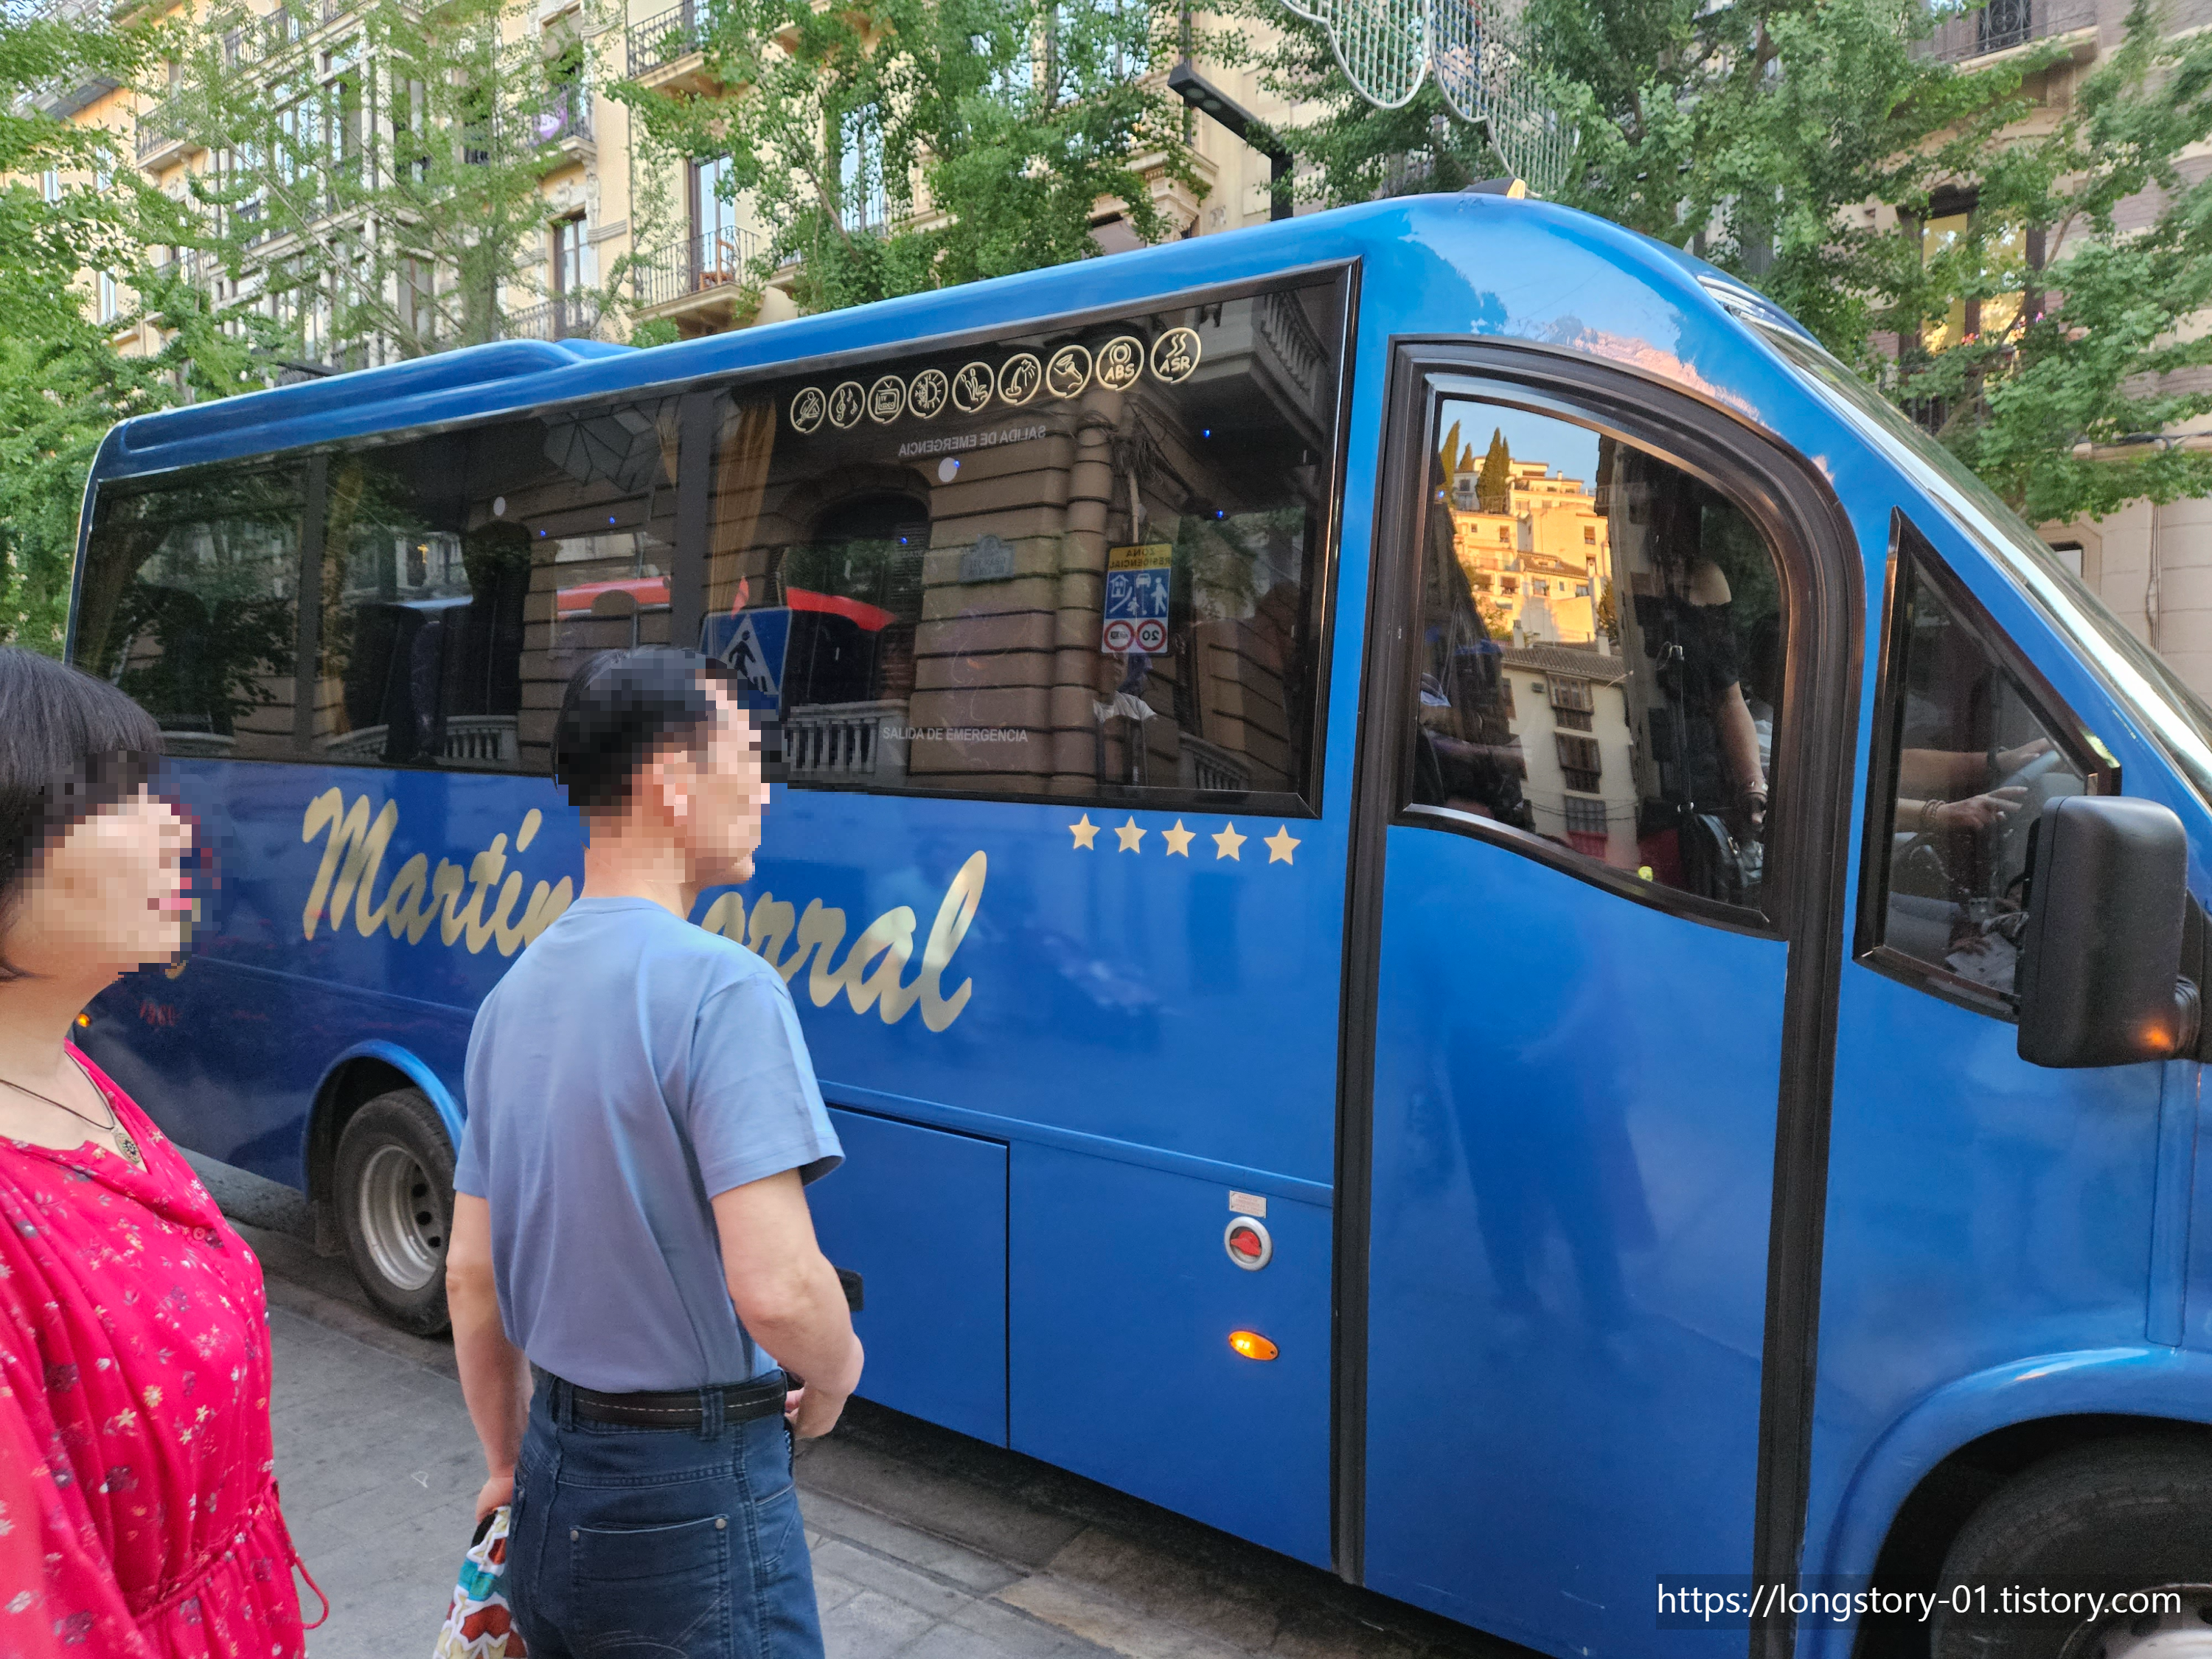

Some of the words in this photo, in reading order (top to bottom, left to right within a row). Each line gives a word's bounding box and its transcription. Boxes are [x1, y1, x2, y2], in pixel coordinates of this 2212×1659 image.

[1104, 363, 1135, 381] ABS
[1158, 355, 1191, 373] ASR
[883, 726, 925, 740] SALIDA
[927, 726, 944, 740] DE
[945, 728, 1029, 742] EMERGENCIA
[700, 849, 988, 1033] orral
